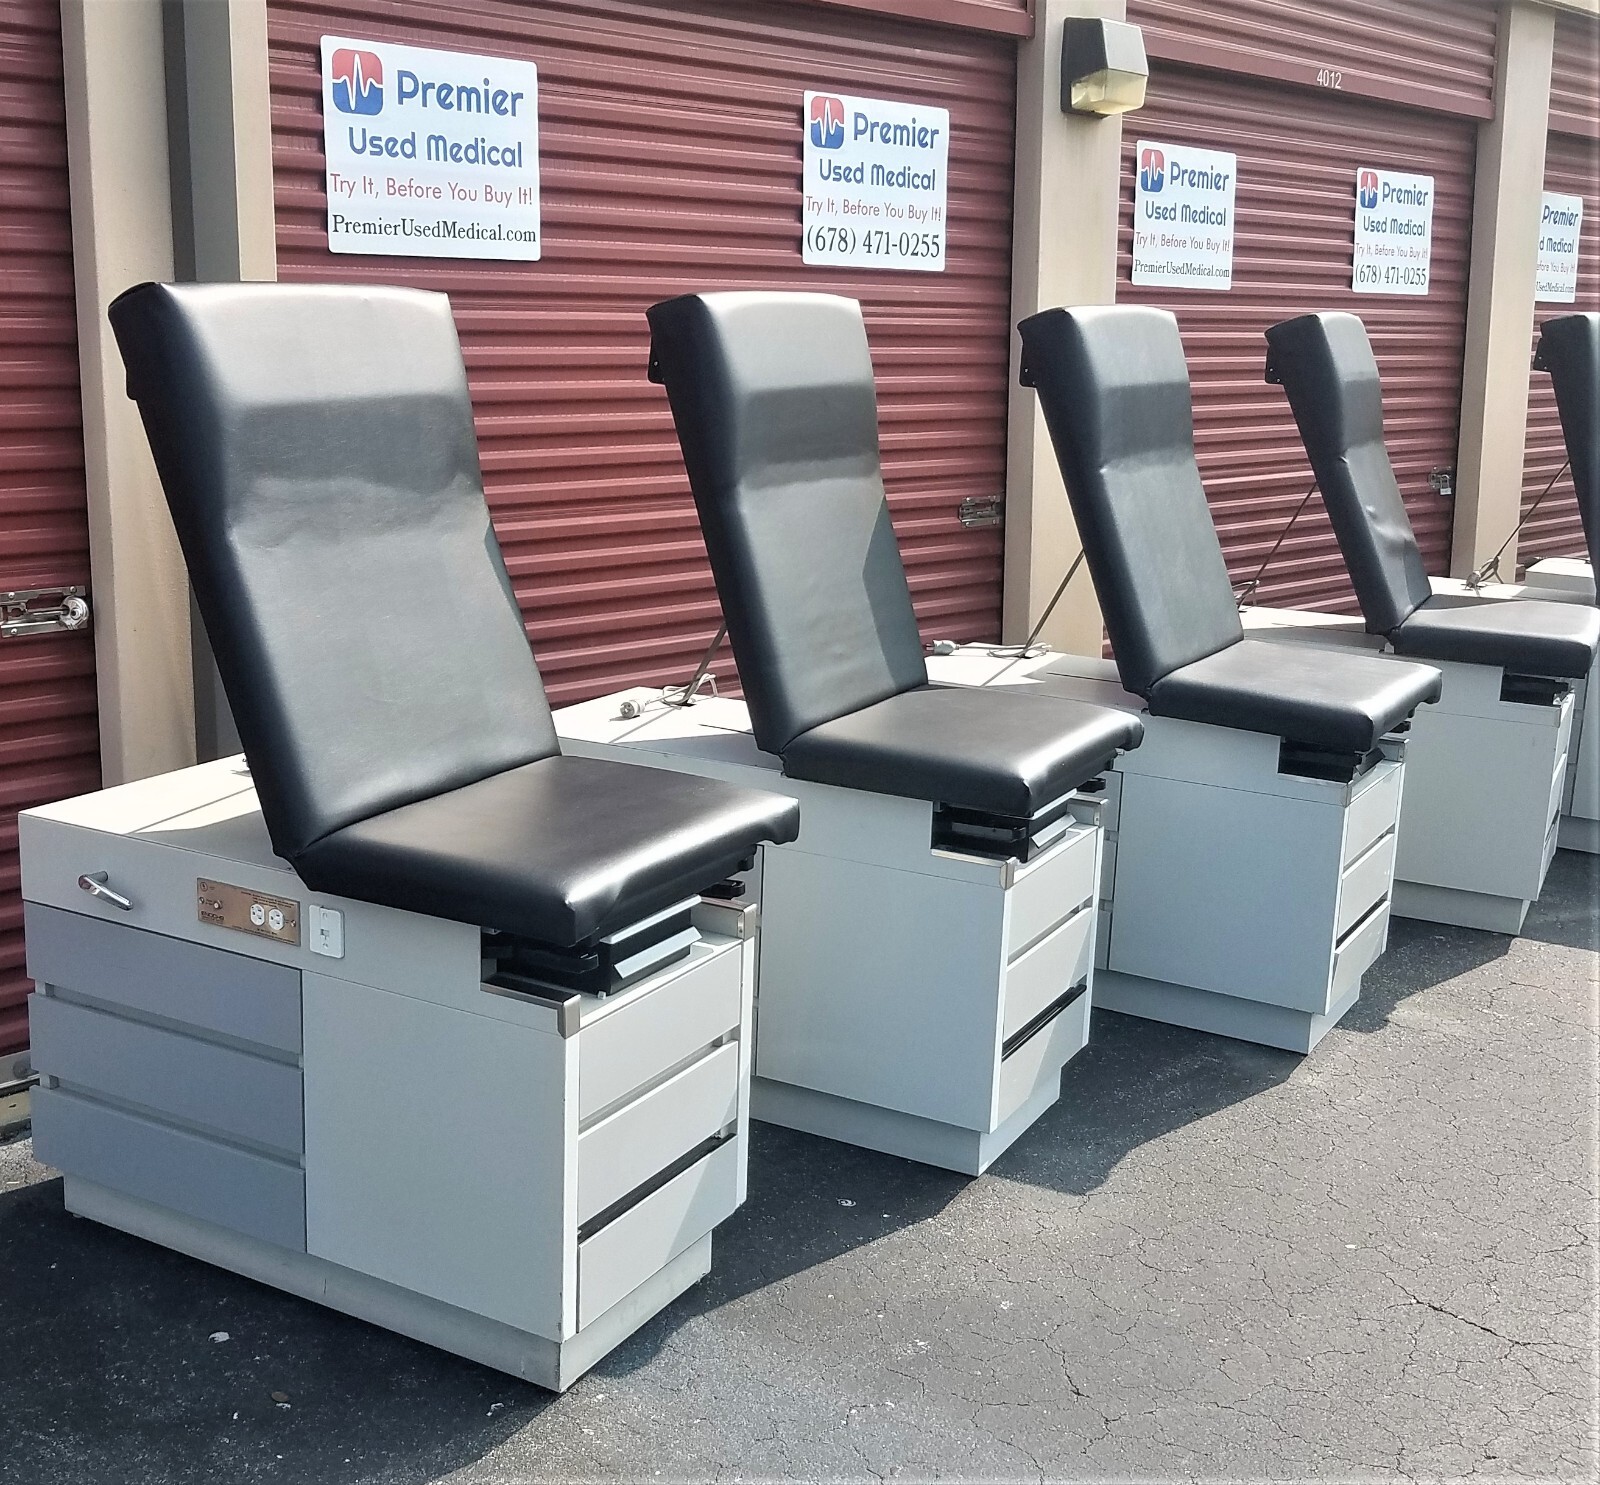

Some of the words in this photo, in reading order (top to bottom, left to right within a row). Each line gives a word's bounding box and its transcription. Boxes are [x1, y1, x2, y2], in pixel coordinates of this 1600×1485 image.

[1317, 69, 1342, 88] 4012
[398, 70, 523, 116] Premier
[854, 112, 939, 149] Premier
[349, 127, 416, 159] Used
[427, 134, 522, 168] Medical
[820, 158, 864, 184] Used
[871, 164, 935, 190] Medical
[1170, 162, 1229, 191] Premier
[330, 174, 356, 198] Try
[363, 176, 379, 199] It,
[387, 178, 442, 199] Before
[448, 182, 477, 201] You
[485, 185, 512, 208] Buy
[519, 187, 532, 205] It!
[1382, 182, 1428, 206] Premier
[806, 196, 823, 217] Try
[828, 198, 837, 215] It,
[843, 199, 880, 216] Before
[884, 202, 903, 218] You
[909, 205, 928, 224] Buy
[931, 207, 941, 221] It!
[1146, 201, 1176, 220] Used
[1181, 204, 1226, 226] Medical
[1542, 205, 1578, 226] Premier
[332, 215, 536, 242] PremierUsedMedical.com
[1364, 216, 1387, 232] Used
[1390, 218, 1425, 236] Medical
[807, 225, 856, 254] (678)
[863, 230, 940, 258] 471-0255
[1136, 232, 1147, 248] Try
[1161, 234, 1186, 248] Before
[1190, 237, 1203, 249] You
[1207, 238, 1220, 254] Buy
[1356, 243, 1364, 255] Try
[1375, 245, 1394, 256] Before
[1397, 246, 1407, 257] You
[1410, 247, 1420, 261] Buy
[1546, 238, 1574, 253] Medical
[1134, 260, 1230, 277] PremierUsedMedical.com
[1356, 264, 1381, 284] (678)
[1385, 267, 1426, 285] 471-0255
